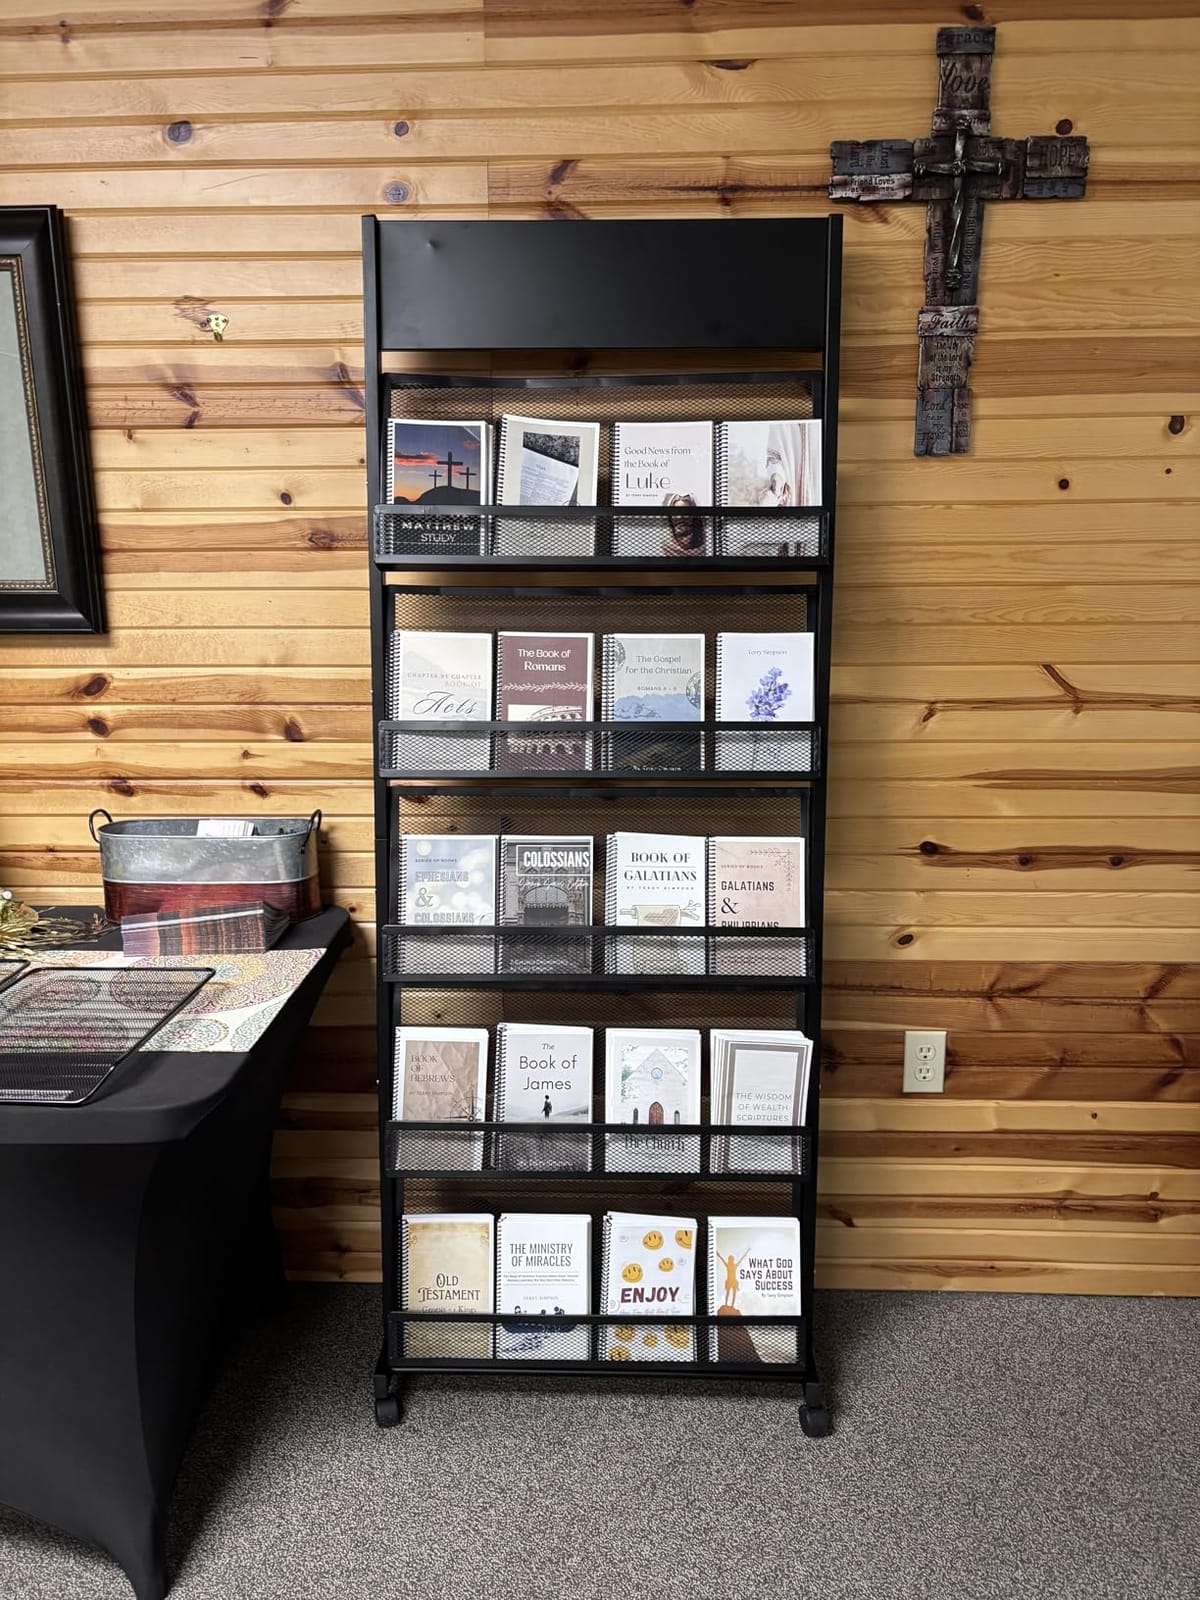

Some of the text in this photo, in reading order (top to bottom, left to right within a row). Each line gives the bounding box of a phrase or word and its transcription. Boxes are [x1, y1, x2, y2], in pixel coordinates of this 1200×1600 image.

[928, 313, 971, 330] Faith
[624, 446, 691, 455] Good News from
[624, 459, 670, 468] the Book of
[625, 472, 671, 490] Luke
[421, 533, 457, 542] STUDY
[518, 649, 571, 658] The Book of
[636, 655, 682, 665] The Gospel
[524, 662, 567, 672] Romans
[625, 666, 693, 675] for the Christian
[413, 691, 478, 715] Acts
[523, 851, 590, 868] COLOSSIANS
[631, 852, 691, 864] BOOK OF
[415, 871, 470, 883] EPHESIANS
[624, 870, 697, 882] GALATIANS
[721, 880, 775, 891] GALATIANS
[414, 887, 434, 908] &
[720, 896, 740, 915] &
[414, 912, 475, 924] COLOSSIANS
[411, 1055, 439, 1063] BOOK
[519, 1055, 578, 1070] Book of
[409, 1074, 456, 1083] HEBREWS
[522, 1077, 572, 1090] James
[736, 1092, 792, 1101] THE WISDOM
[738, 1103, 750, 1111] OF
[736, 1114, 789, 1122] SCRIPTURES
[510, 1243, 573, 1254] THE MINISTRY
[511, 1255, 571, 1267] OF MIRACLES
[749, 1257, 793, 1269] WHAT GOD
[740, 1269, 793, 1280] SAYS ABOUT
[755, 1280, 793, 1291] SUCCESS
[620, 1286, 680, 1304] ENJOY
